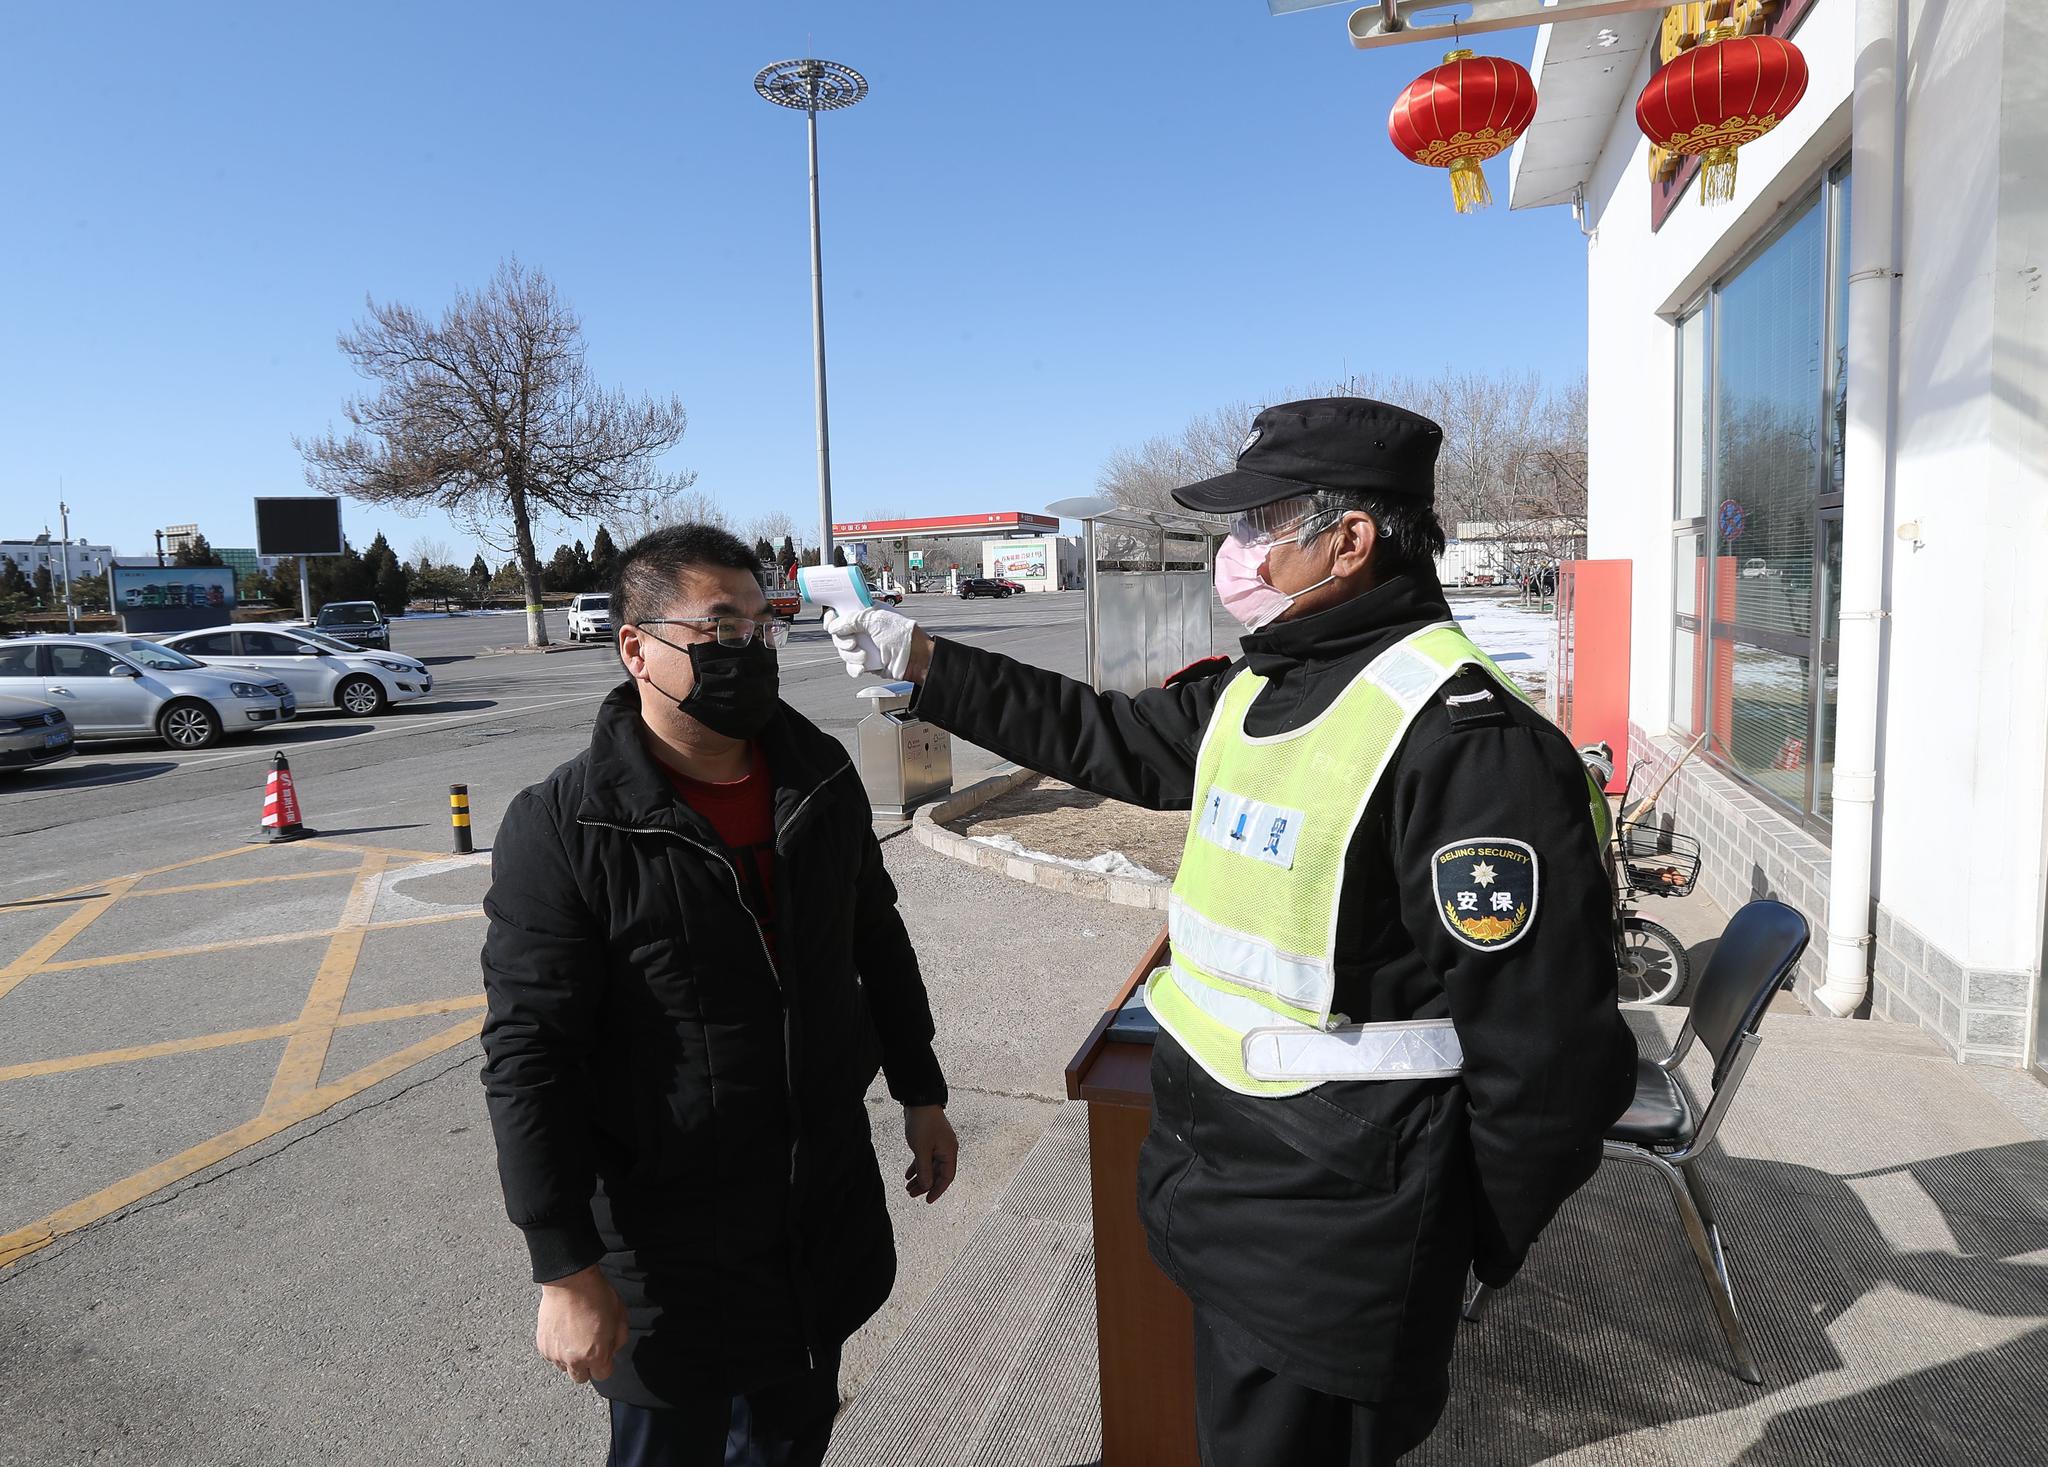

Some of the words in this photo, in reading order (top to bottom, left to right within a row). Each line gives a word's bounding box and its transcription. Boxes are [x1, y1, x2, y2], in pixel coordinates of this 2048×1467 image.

[1440, 847, 1475, 864] BEIJING
[1477, 848, 1530, 865] SECURITY
[1457, 891, 1514, 912] 安保
